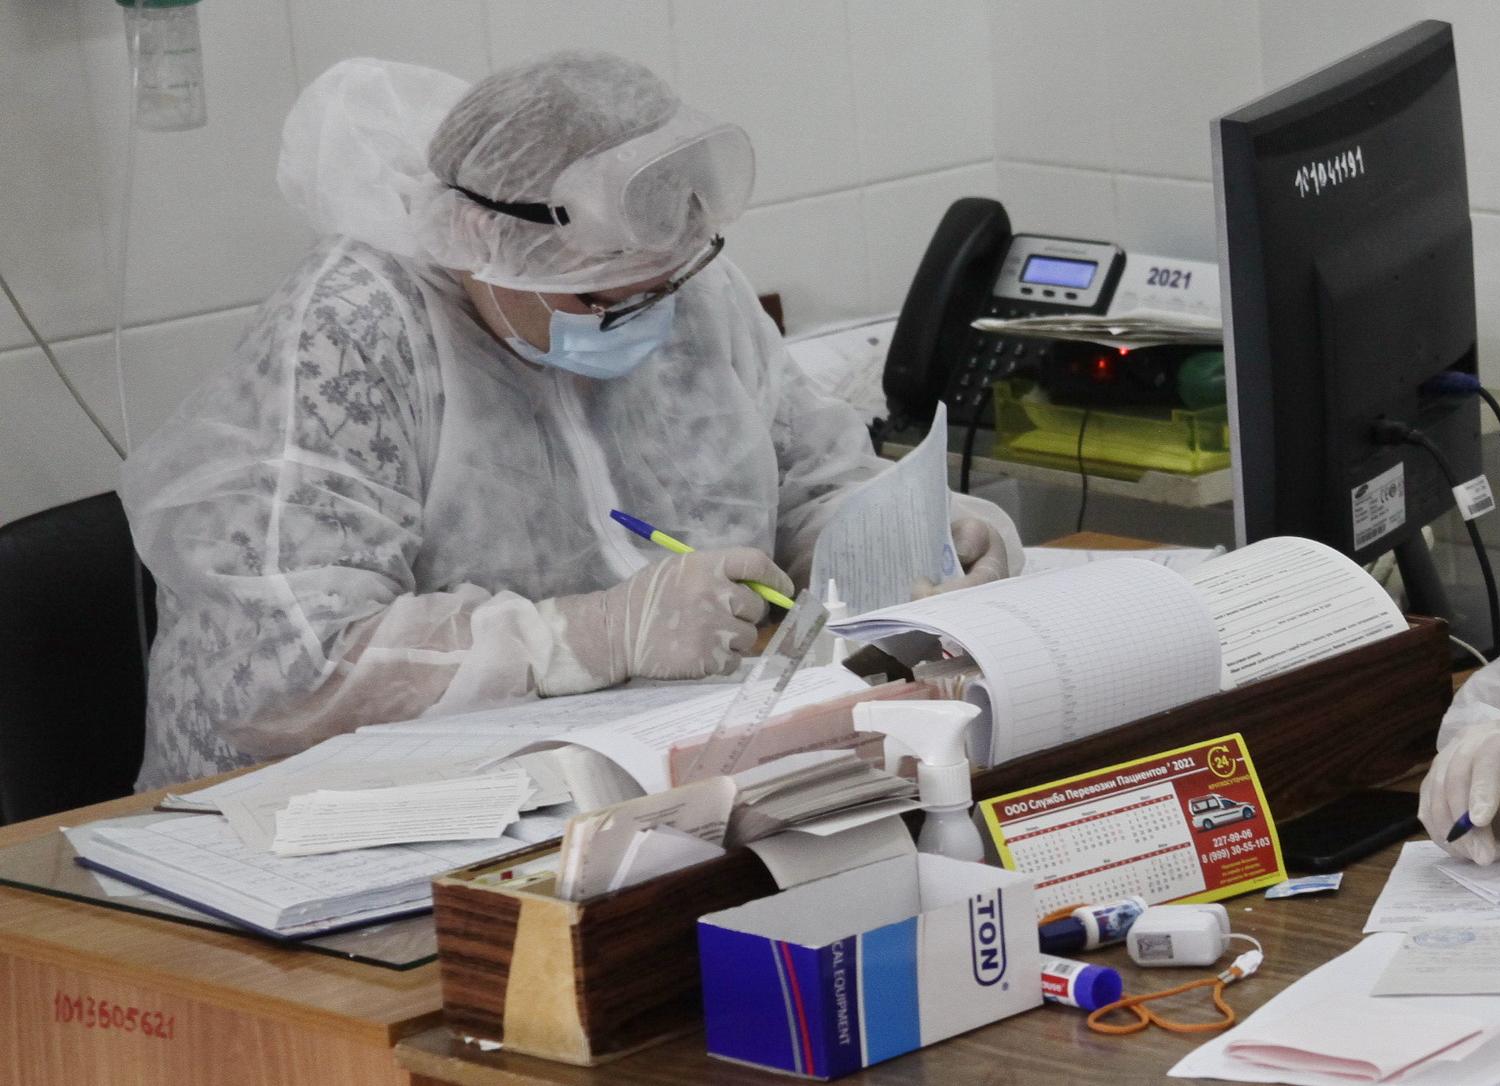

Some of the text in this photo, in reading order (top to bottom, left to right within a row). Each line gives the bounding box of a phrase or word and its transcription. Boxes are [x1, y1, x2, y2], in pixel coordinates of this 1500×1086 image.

[1147, 267, 1193, 290] 2021
[1214, 755, 1230, 769] 24
[1004, 801, 1028, 816] ООО
[1029, 792, 1066, 812] Служба
[1065, 780, 1118, 802] Перевозки
[1173, 756, 1196, 771] 2021
[1201, 854, 1208, 864] 8
[1230, 836, 1271, 856] 30-55-103
[1212, 828, 1253, 848] 227-99-06
[976, 894, 999, 971] TON
[834, 968, 850, 1046] EQUIPMENT
